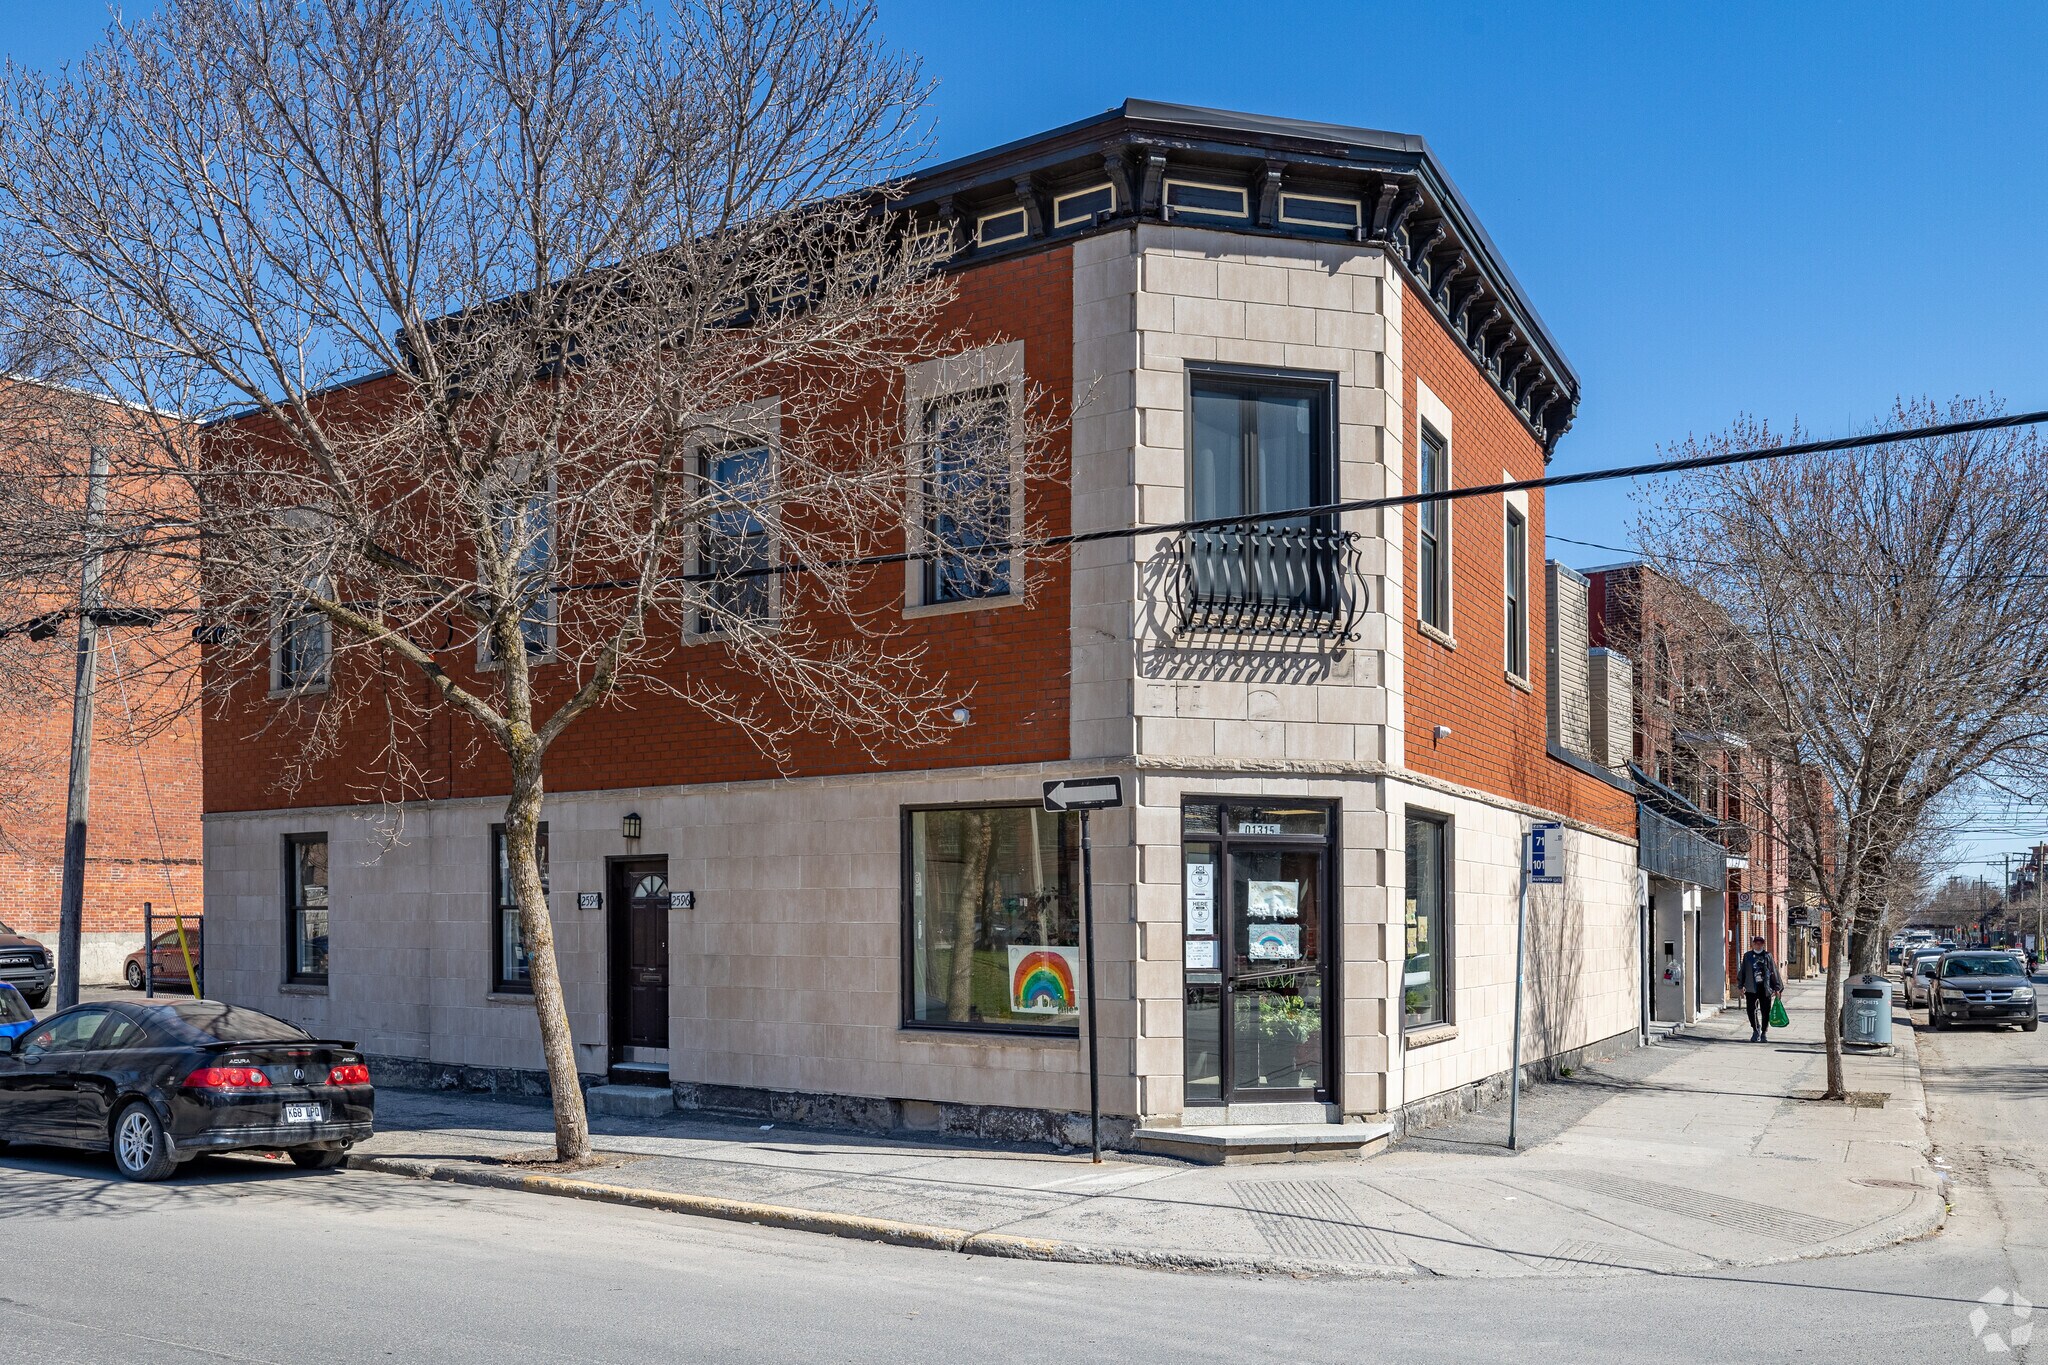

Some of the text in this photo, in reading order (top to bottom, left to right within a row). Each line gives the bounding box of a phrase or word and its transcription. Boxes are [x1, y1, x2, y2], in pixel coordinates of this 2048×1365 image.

[1536, 837, 1545, 846] 71
[1533, 860, 1545, 869] 101
[671, 895, 691, 907] 2596
[288, 1107, 303, 1118] K68
